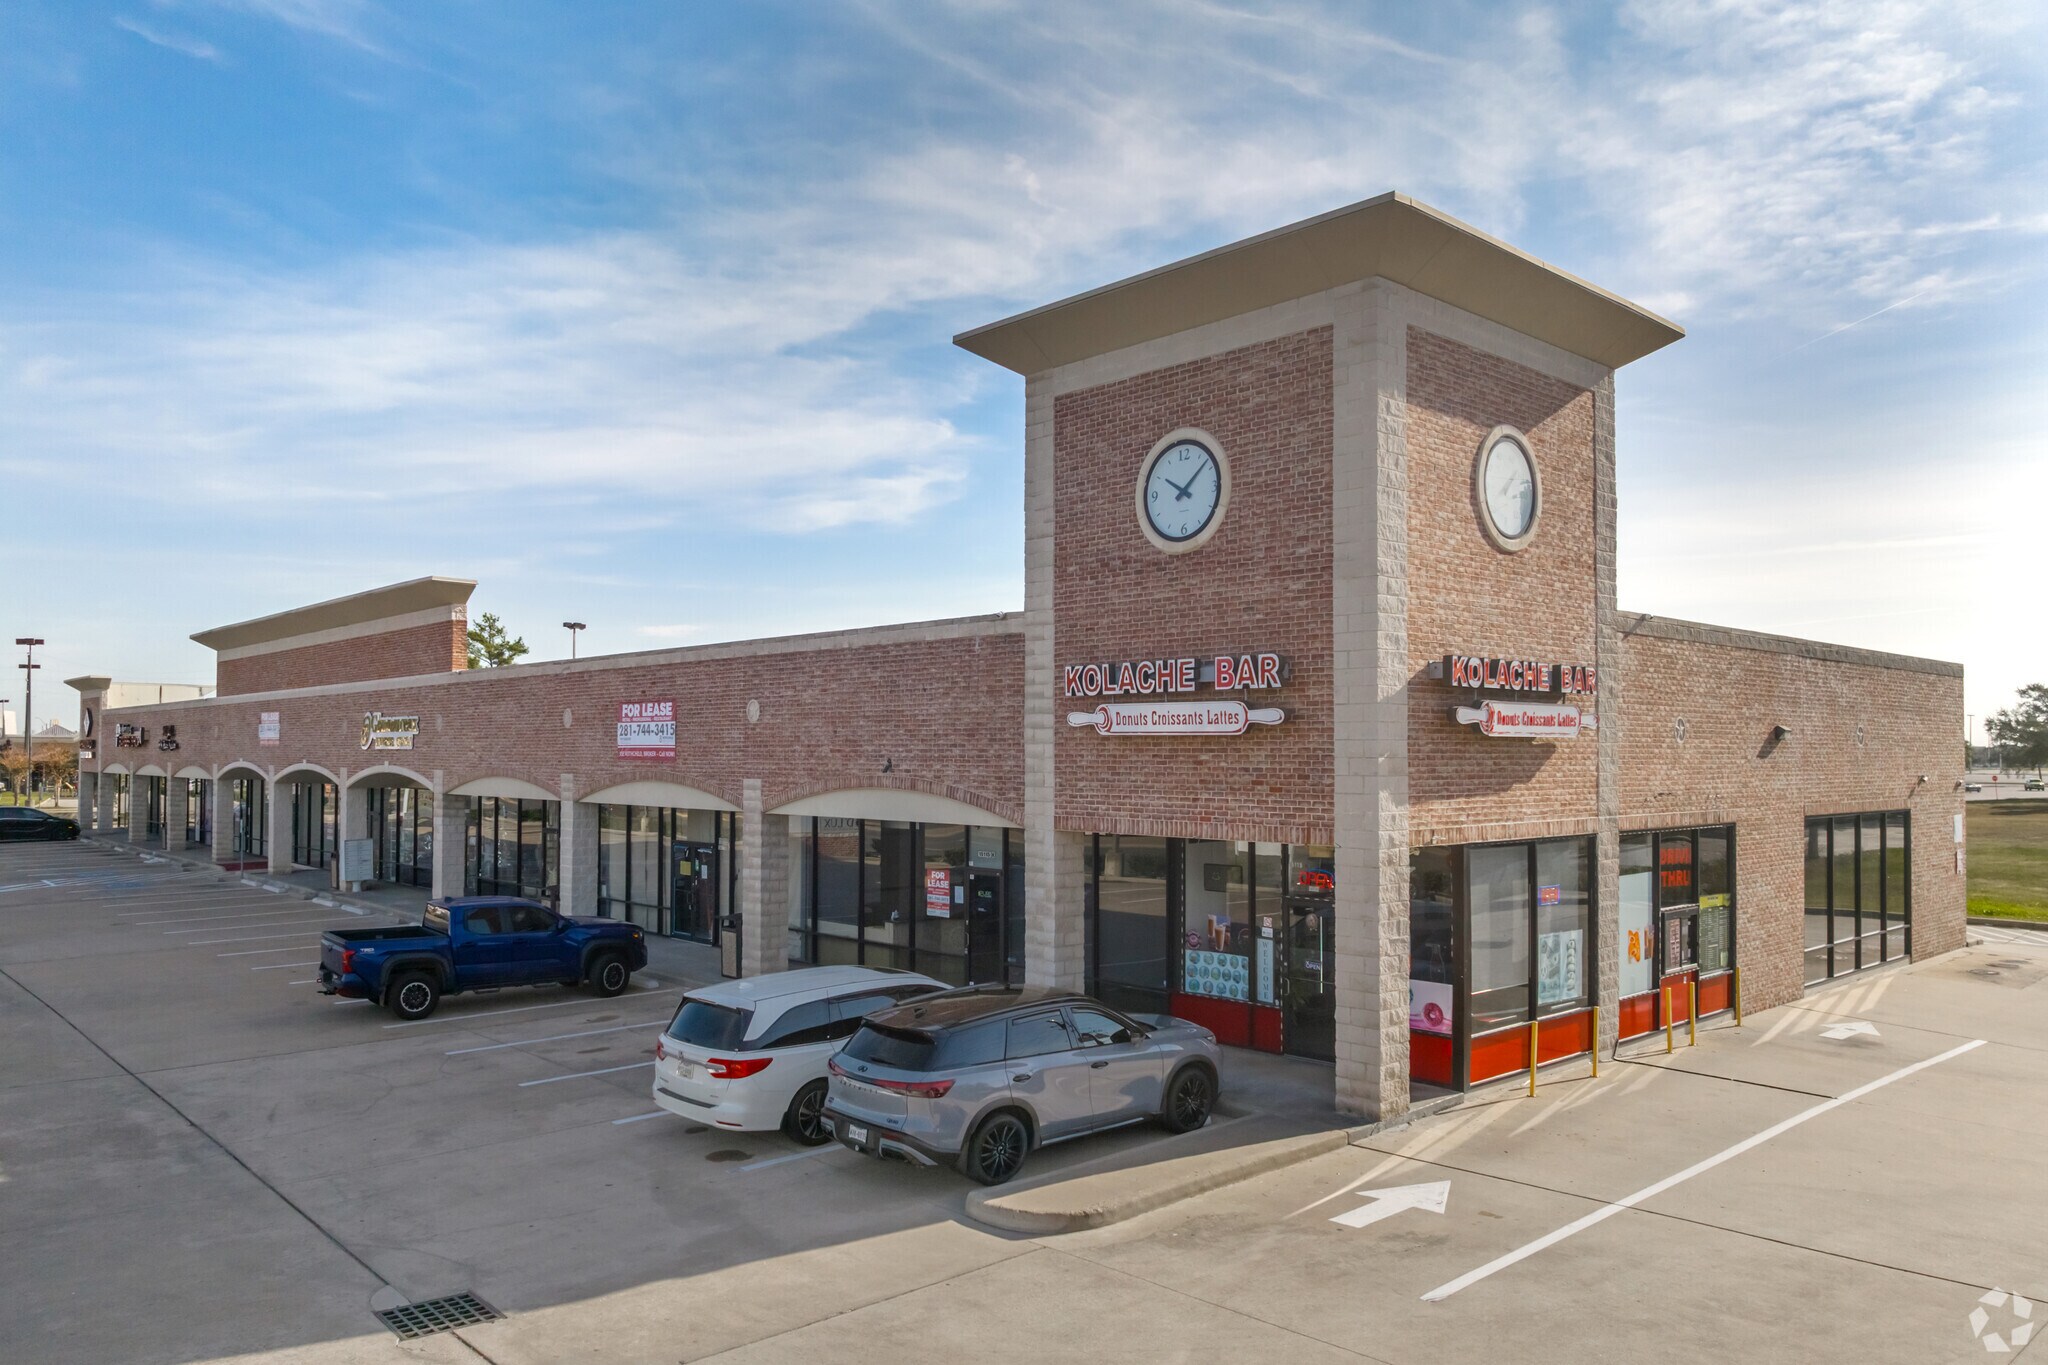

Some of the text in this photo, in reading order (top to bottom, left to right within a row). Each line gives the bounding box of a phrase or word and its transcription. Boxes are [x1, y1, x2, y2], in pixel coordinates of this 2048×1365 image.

[1179, 448, 1190, 461] 12
[1211, 480, 1217, 493] 3
[1151, 490, 1158, 503] 9
[1180, 523, 1187, 536] 6
[1064, 653, 1282, 697] KOLACHE BAR
[1452, 655, 1598, 695] KOLACHE BAR
[622, 702, 673, 717] FOR LEASE
[1115, 709, 1240, 726] Donuts Croissants Lattes
[1497, 710, 1577, 727] Donuts Croissants Lattes
[619, 724, 675, 736] 281-744-3415
[931, 871, 945, 880] FOR
[1300, 871, 1333, 889] OPEN
[927, 879, 949, 889] LEASE
[1305, 962, 1320, 971] OPEN
